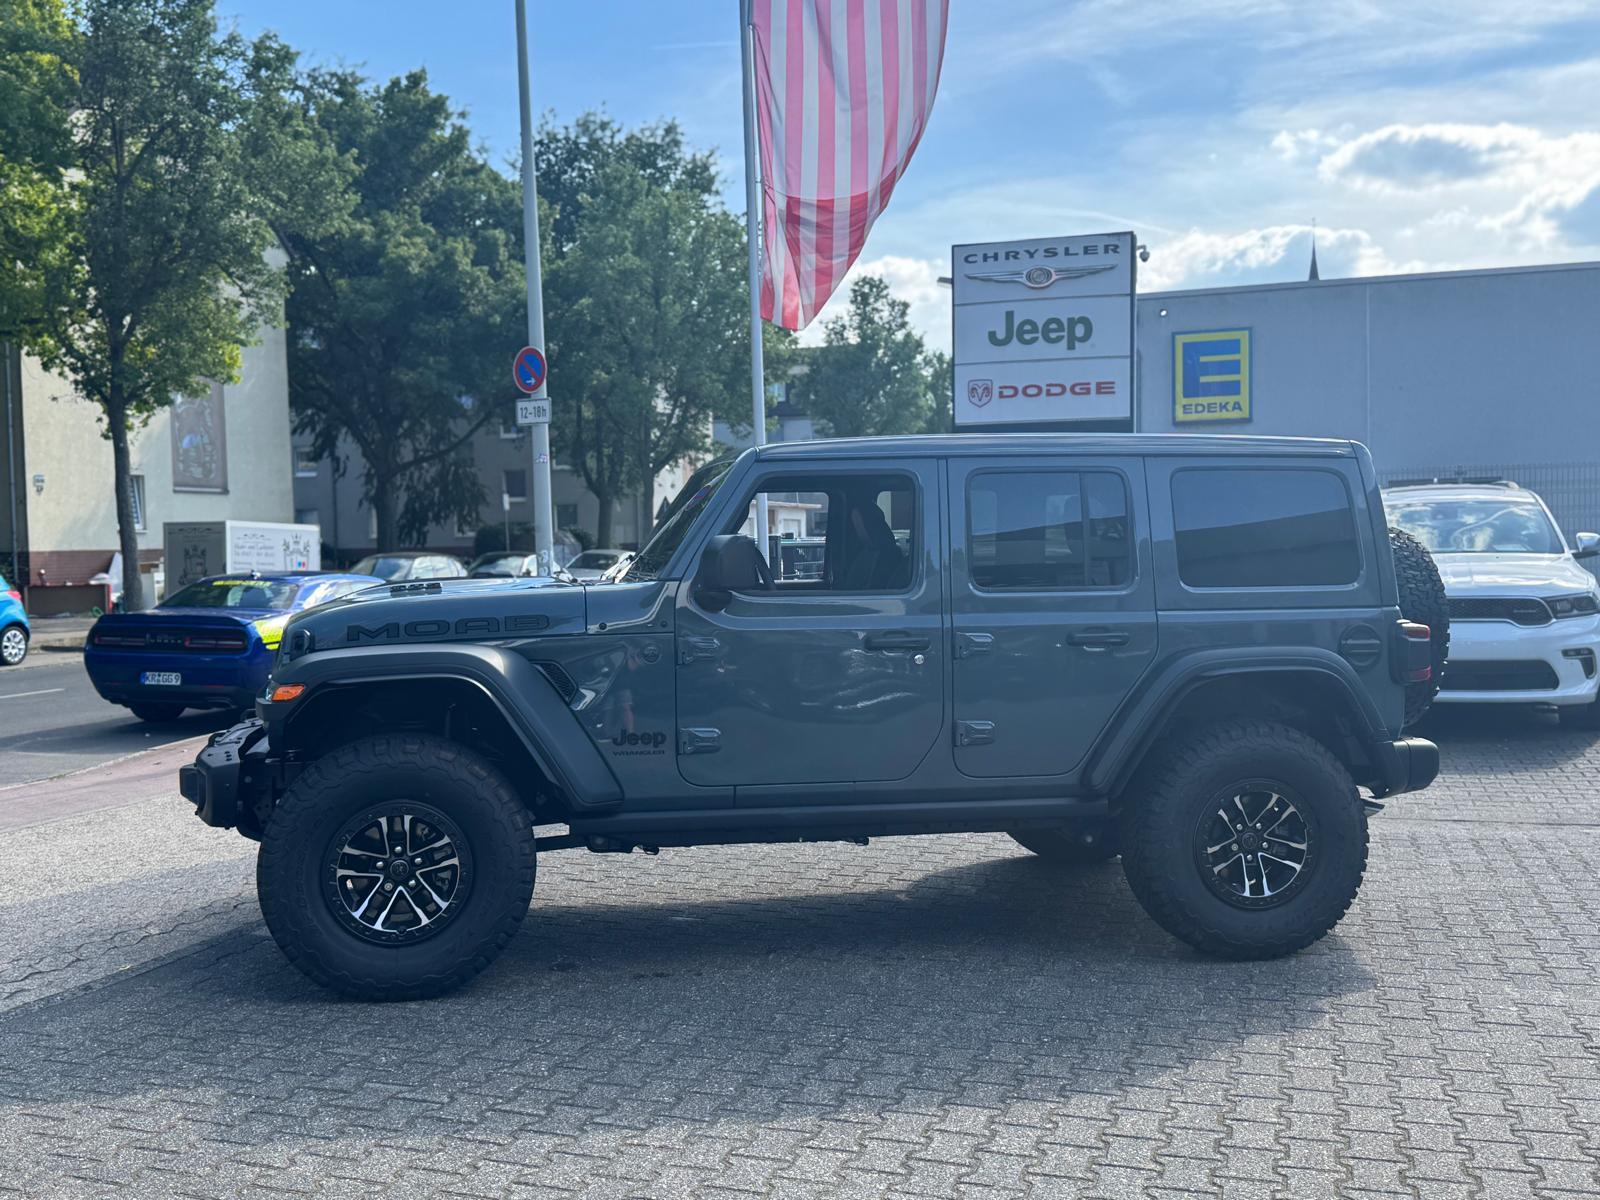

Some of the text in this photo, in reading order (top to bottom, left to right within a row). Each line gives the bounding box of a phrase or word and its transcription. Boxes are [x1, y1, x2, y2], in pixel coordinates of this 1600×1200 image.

[963, 244, 1121, 264] CHRYSLER
[987, 312, 1093, 350] Jeep
[998, 381, 1116, 399] DODGE
[1182, 401, 1243, 415] EDEKA
[346, 614, 550, 642] MOAB
[612, 728, 667, 748] Jeep
